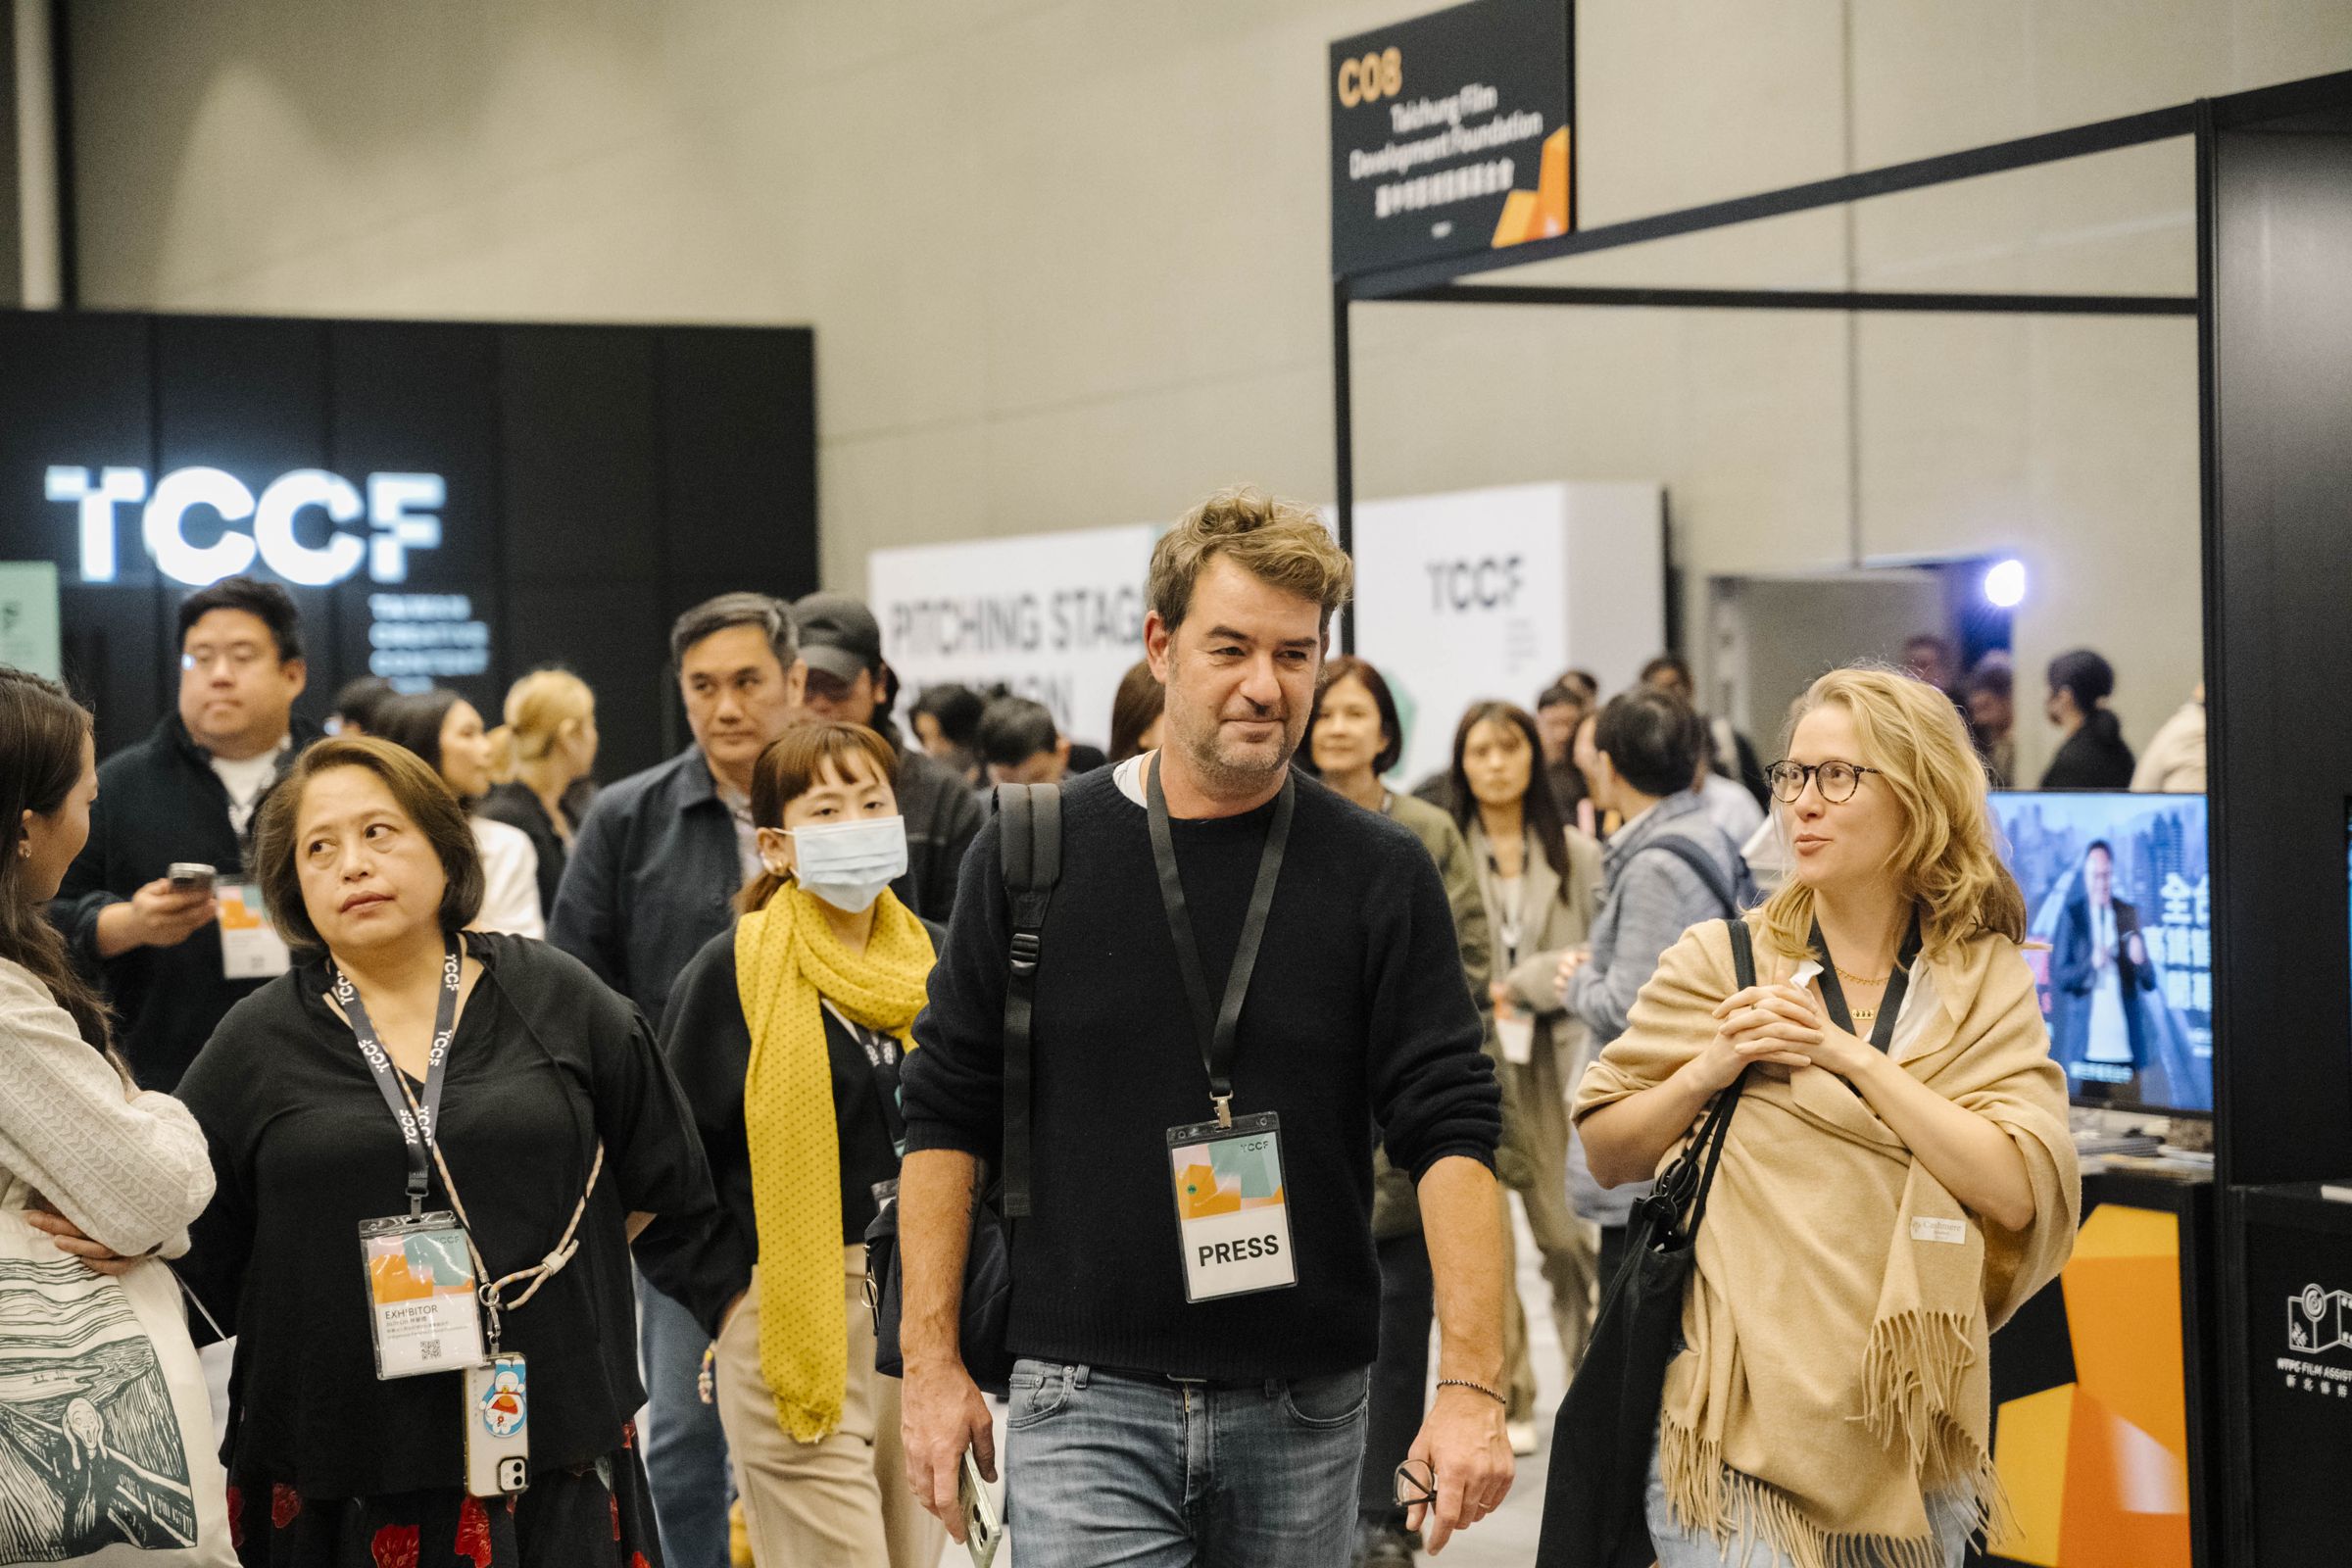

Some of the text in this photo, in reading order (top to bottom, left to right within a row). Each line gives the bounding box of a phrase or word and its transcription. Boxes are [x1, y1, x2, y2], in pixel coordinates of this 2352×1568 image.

[45, 465, 447, 586] TCCF
[1426, 552, 1524, 612] TCCF
[891, 584, 1145, 655] PITCHING STAG
[444, 954, 461, 992] TCCF
[358, 1039, 390, 1073] TCCF
[429, 1029, 453, 1066] TCCF
[399, 1109, 418, 1145] TCCF
[1240, 1140, 1268, 1152] TCCF
[1198, 1234, 1280, 1267] PRESS
[385, 1304, 438, 1320] EXHIBITOR
[2302, 1362, 2323, 1377] FILM
